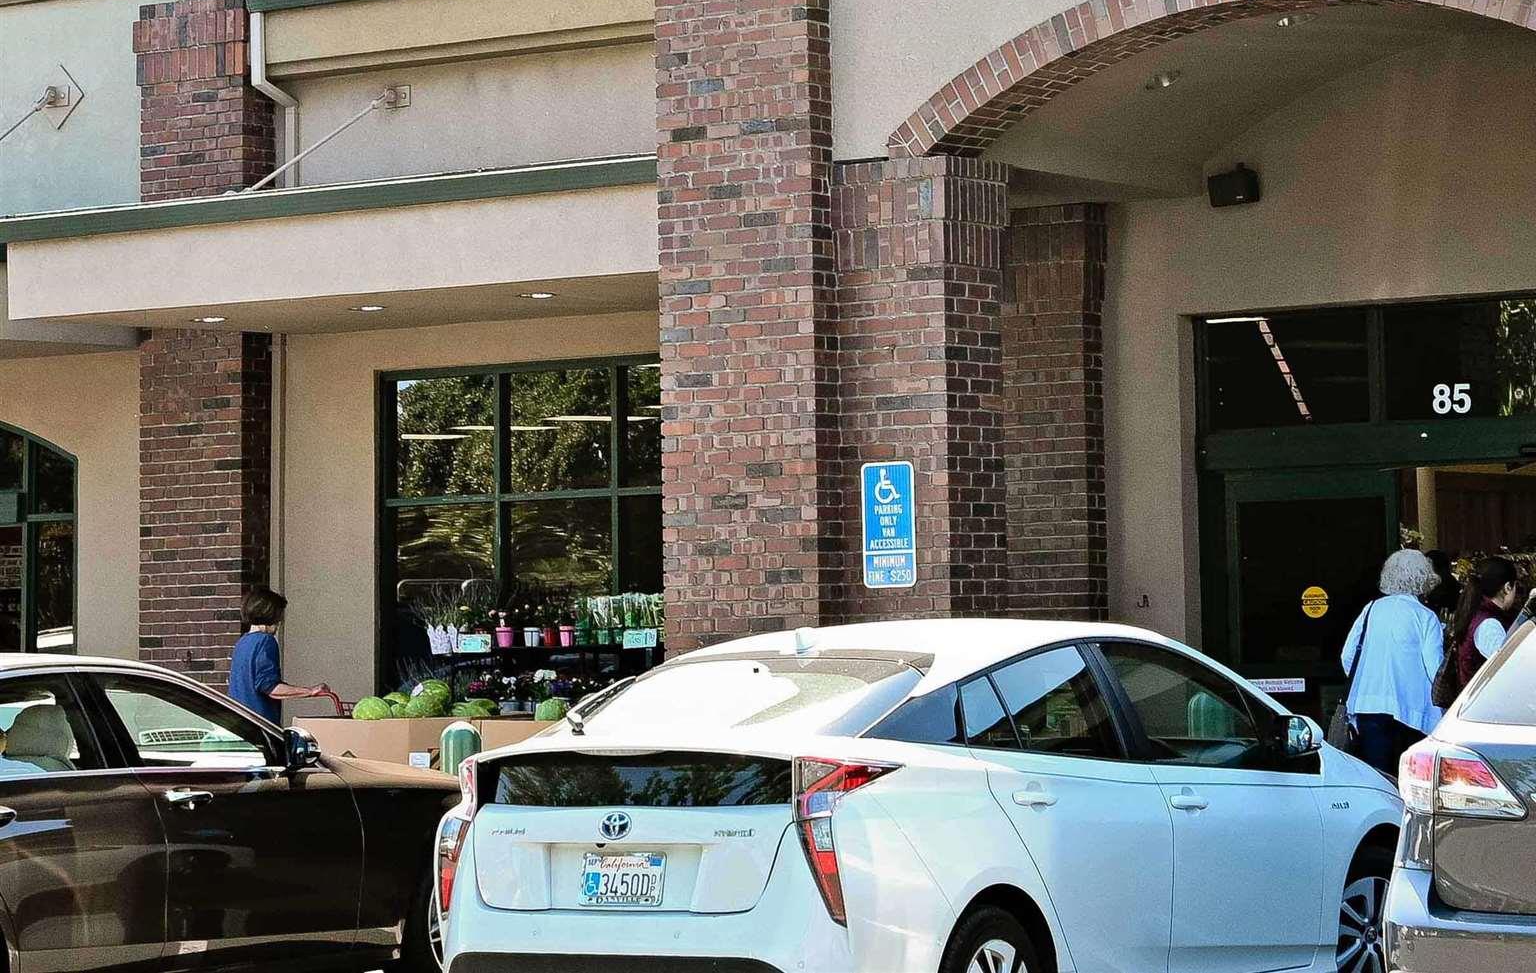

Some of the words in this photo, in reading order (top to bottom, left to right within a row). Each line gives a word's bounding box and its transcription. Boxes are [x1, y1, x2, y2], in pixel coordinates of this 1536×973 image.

[1432, 383, 1472, 415] 85
[874, 504, 903, 516] PARKING
[879, 515, 898, 526] ONLY
[882, 527, 896, 538] VAN
[870, 538, 909, 550] ACCESSIBLE
[873, 555, 906, 569] MINIMUM
[868, 570, 885, 582] FINE
[890, 569, 912, 582] $250
[600, 857, 649, 873] California
